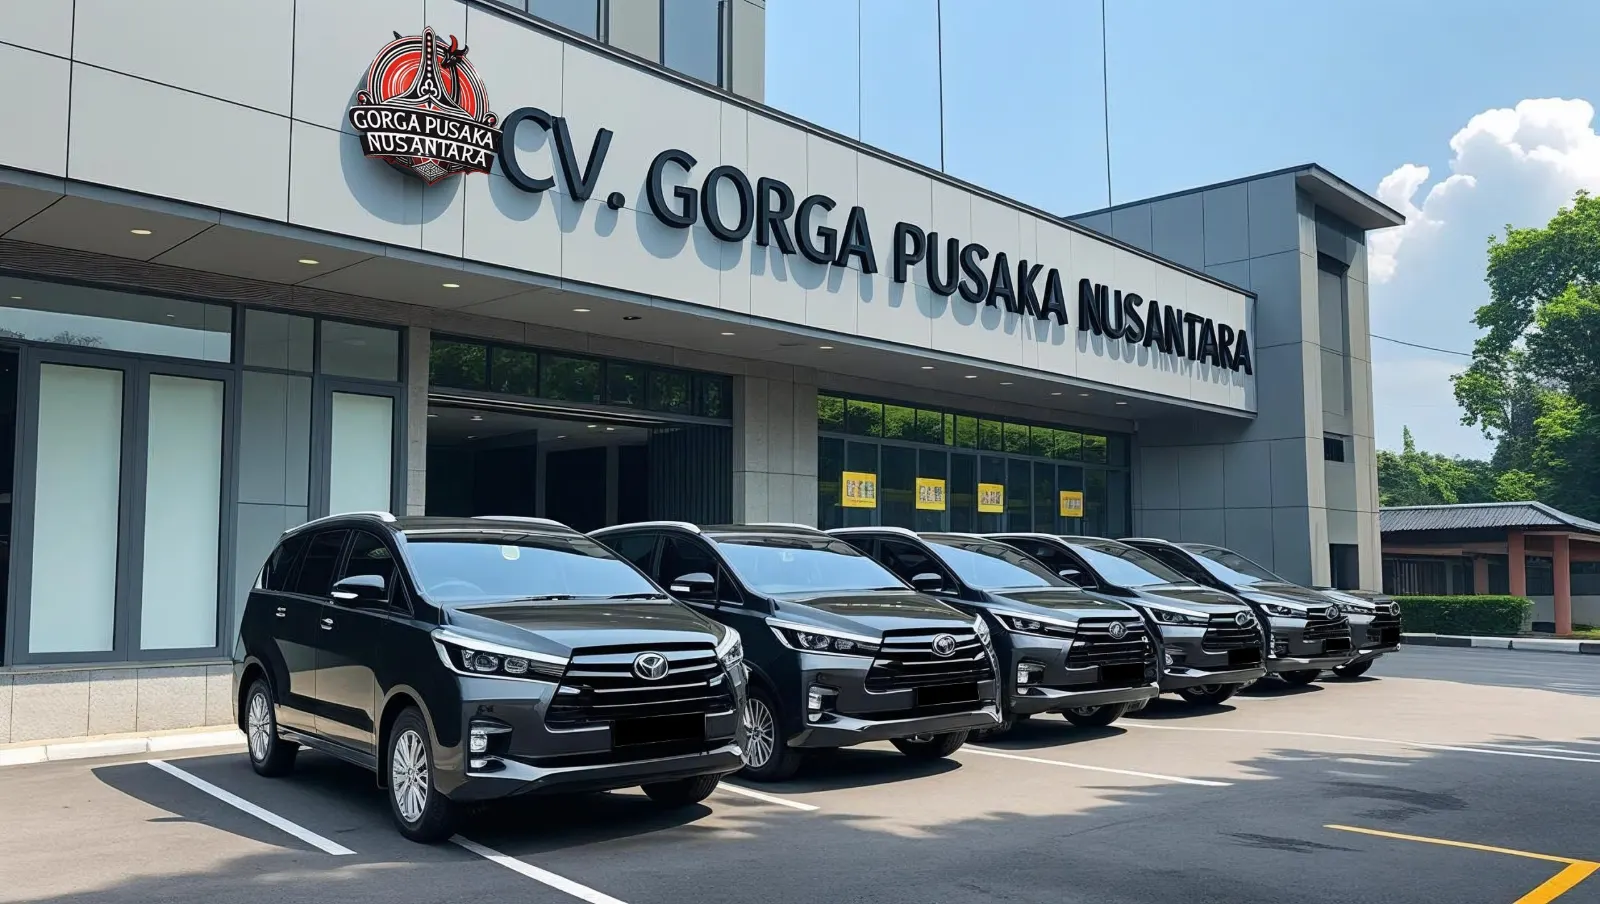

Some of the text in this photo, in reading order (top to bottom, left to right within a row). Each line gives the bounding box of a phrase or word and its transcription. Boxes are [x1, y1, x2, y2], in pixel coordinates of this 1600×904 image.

[353, 109, 494, 149] GORGA PUSAKA
[367, 133, 487, 168] NUSANTARA
[498, 106, 1253, 376] CV. GORGA PUSAKA NUSANTARA
